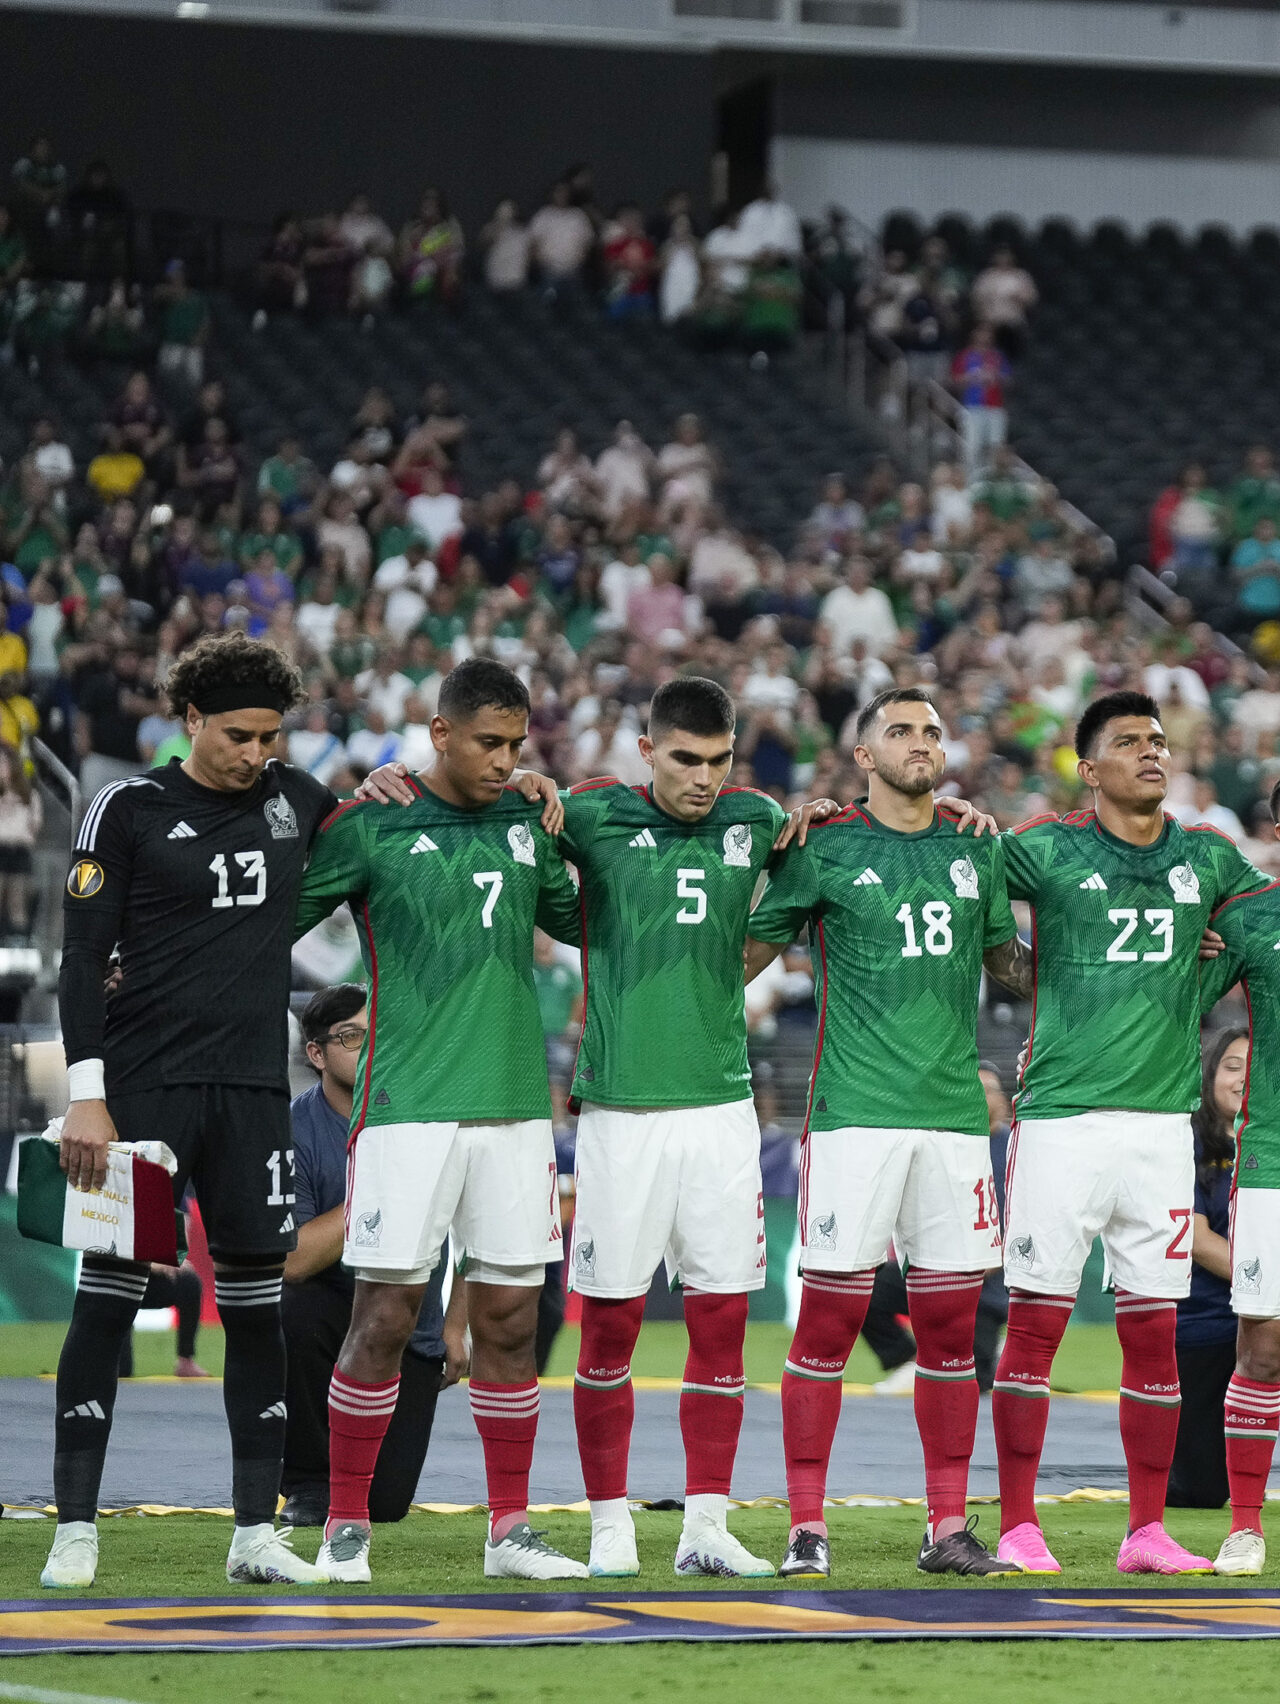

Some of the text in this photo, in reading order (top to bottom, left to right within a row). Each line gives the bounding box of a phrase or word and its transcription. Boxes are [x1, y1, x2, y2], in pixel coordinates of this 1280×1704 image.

[209, 850, 267, 908] 13
[473, 871, 503, 929] 7
[676, 868, 708, 925] 5
[895, 901, 953, 958] 18
[1106, 908, 1174, 963] 23
[81, 1208, 119, 1225] MEXICO
[1166, 1208, 1195, 1260] 2
